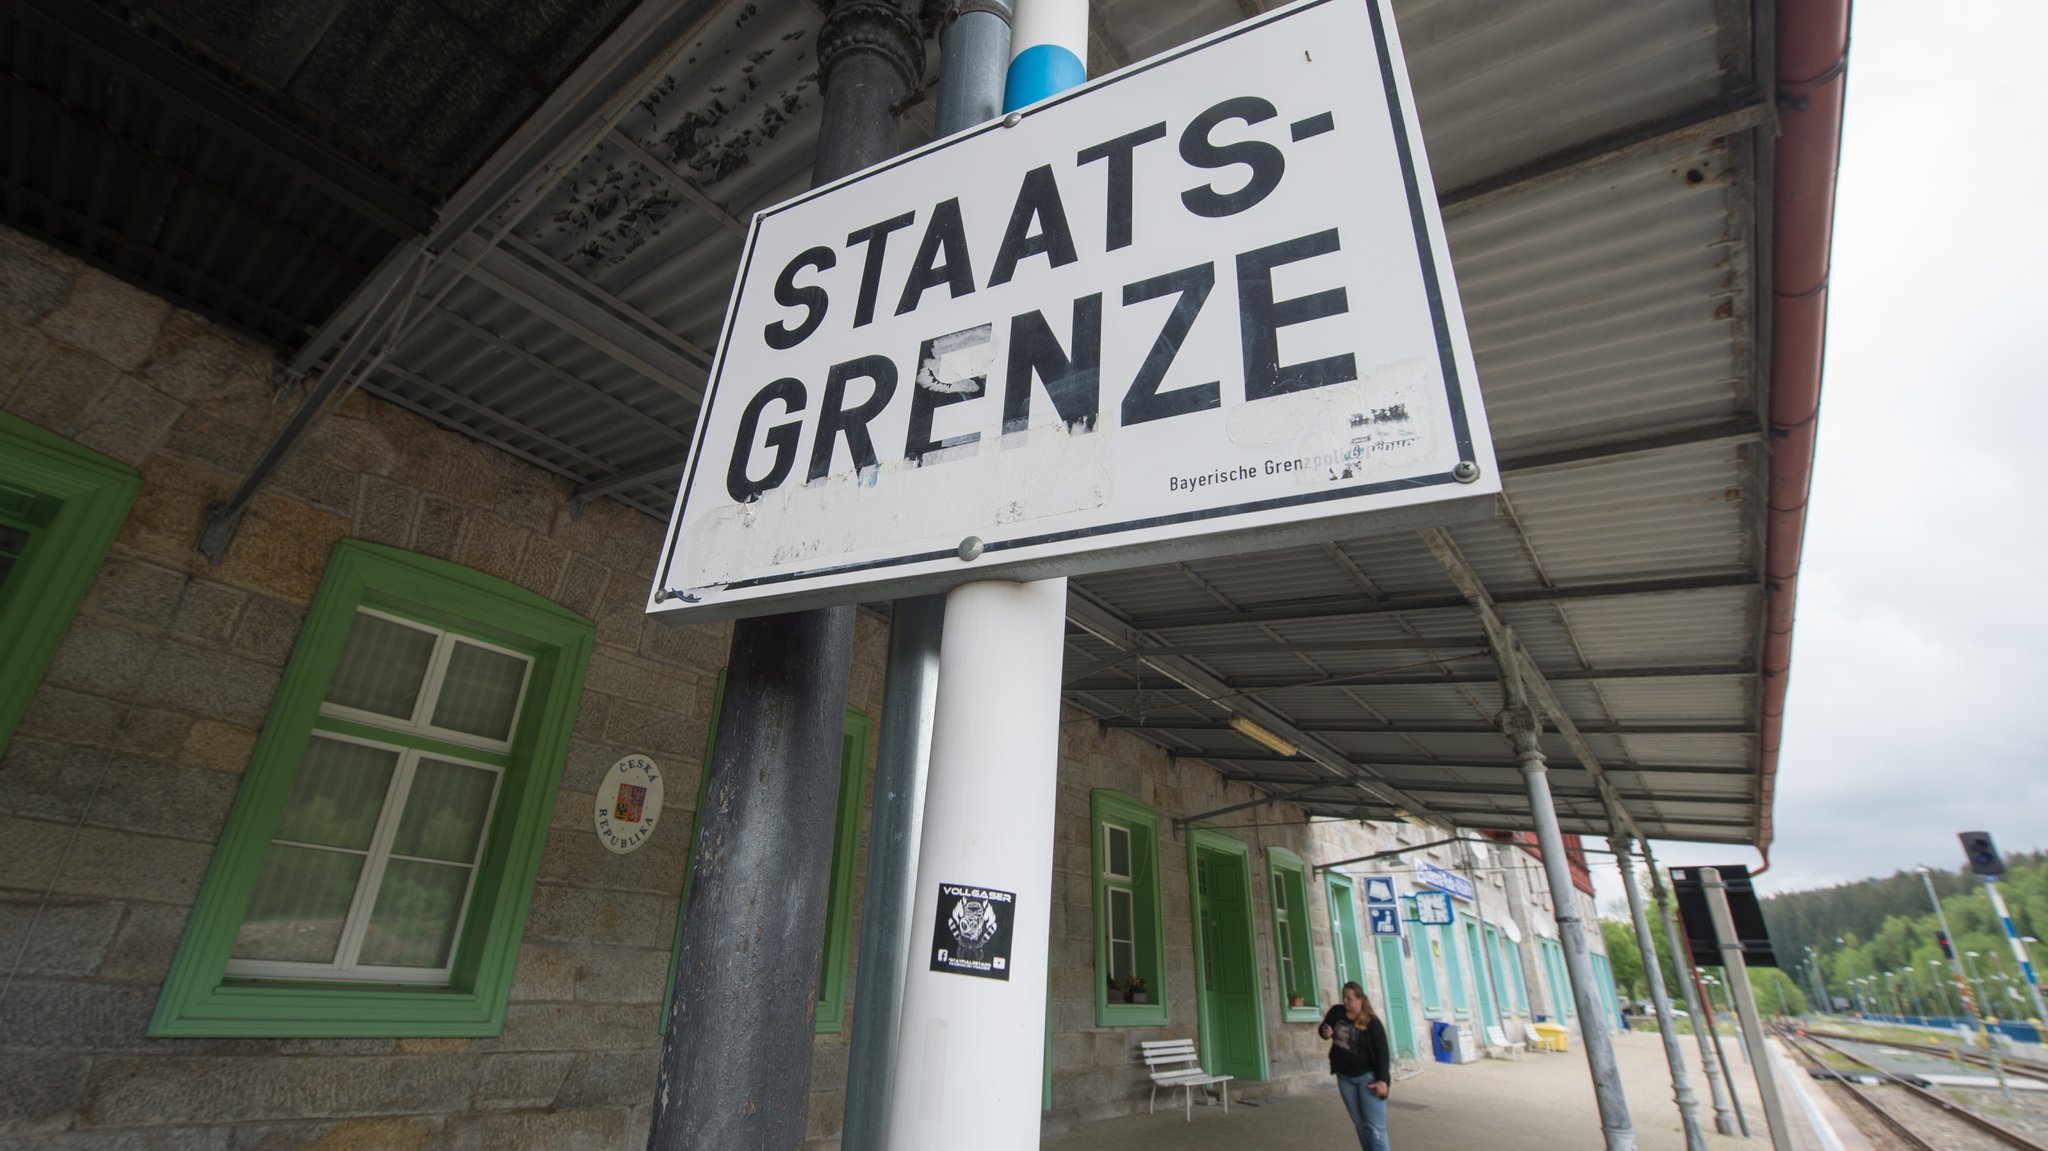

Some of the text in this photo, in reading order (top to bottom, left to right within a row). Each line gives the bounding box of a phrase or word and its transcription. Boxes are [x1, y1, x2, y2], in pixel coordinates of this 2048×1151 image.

[763, 95, 1335, 350] STAATS-
[725, 226, 1358, 504] GRENZE
[1169, 465, 1257, 492] Bayerische
[599, 808, 653, 848] REPUBLIKA
[943, 886, 1012, 903] VOLLGASER
